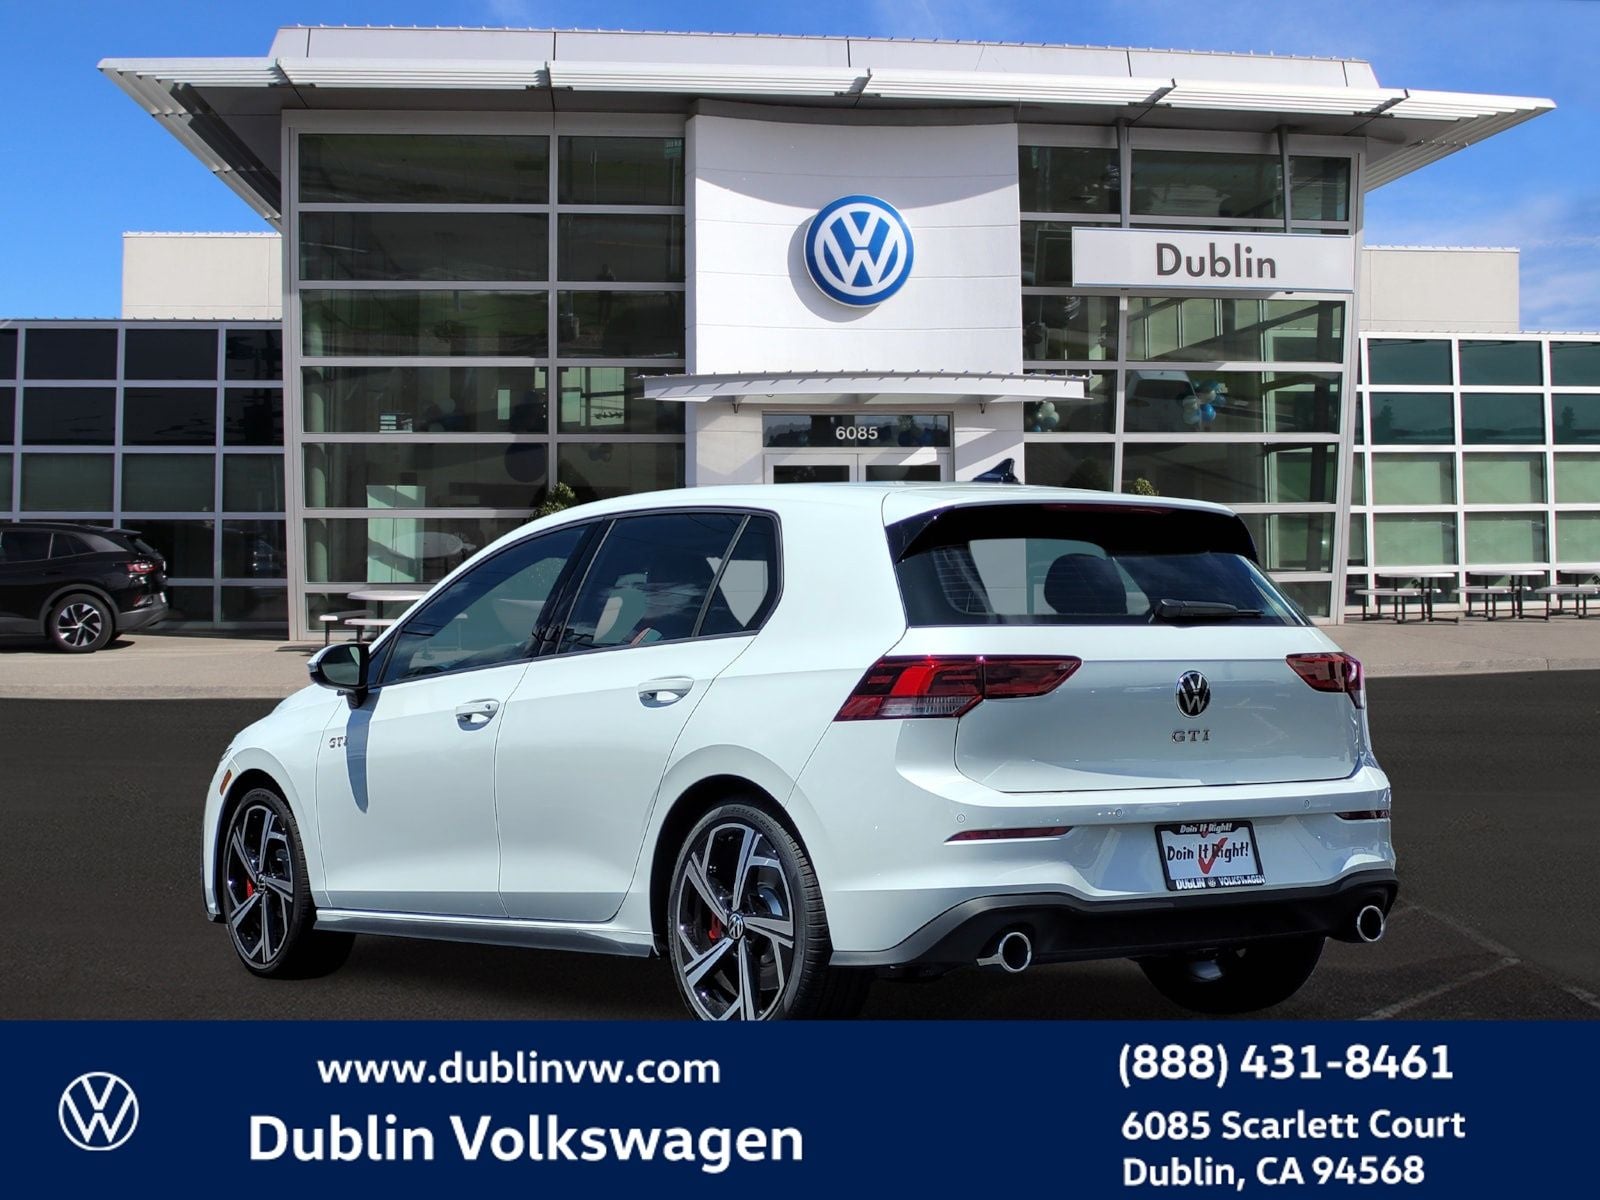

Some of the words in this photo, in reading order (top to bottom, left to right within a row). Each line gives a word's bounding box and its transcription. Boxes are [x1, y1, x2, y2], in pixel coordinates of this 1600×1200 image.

[1156, 242, 1276, 279] Dublin
[835, 426, 878, 440] 6085
[1171, 728, 1211, 743] GTI
[1198, 843, 1208, 859] It
[1175, 877, 1206, 890] DUBLIN
[1218, 874, 1266, 886] VOLKSWAGEN
